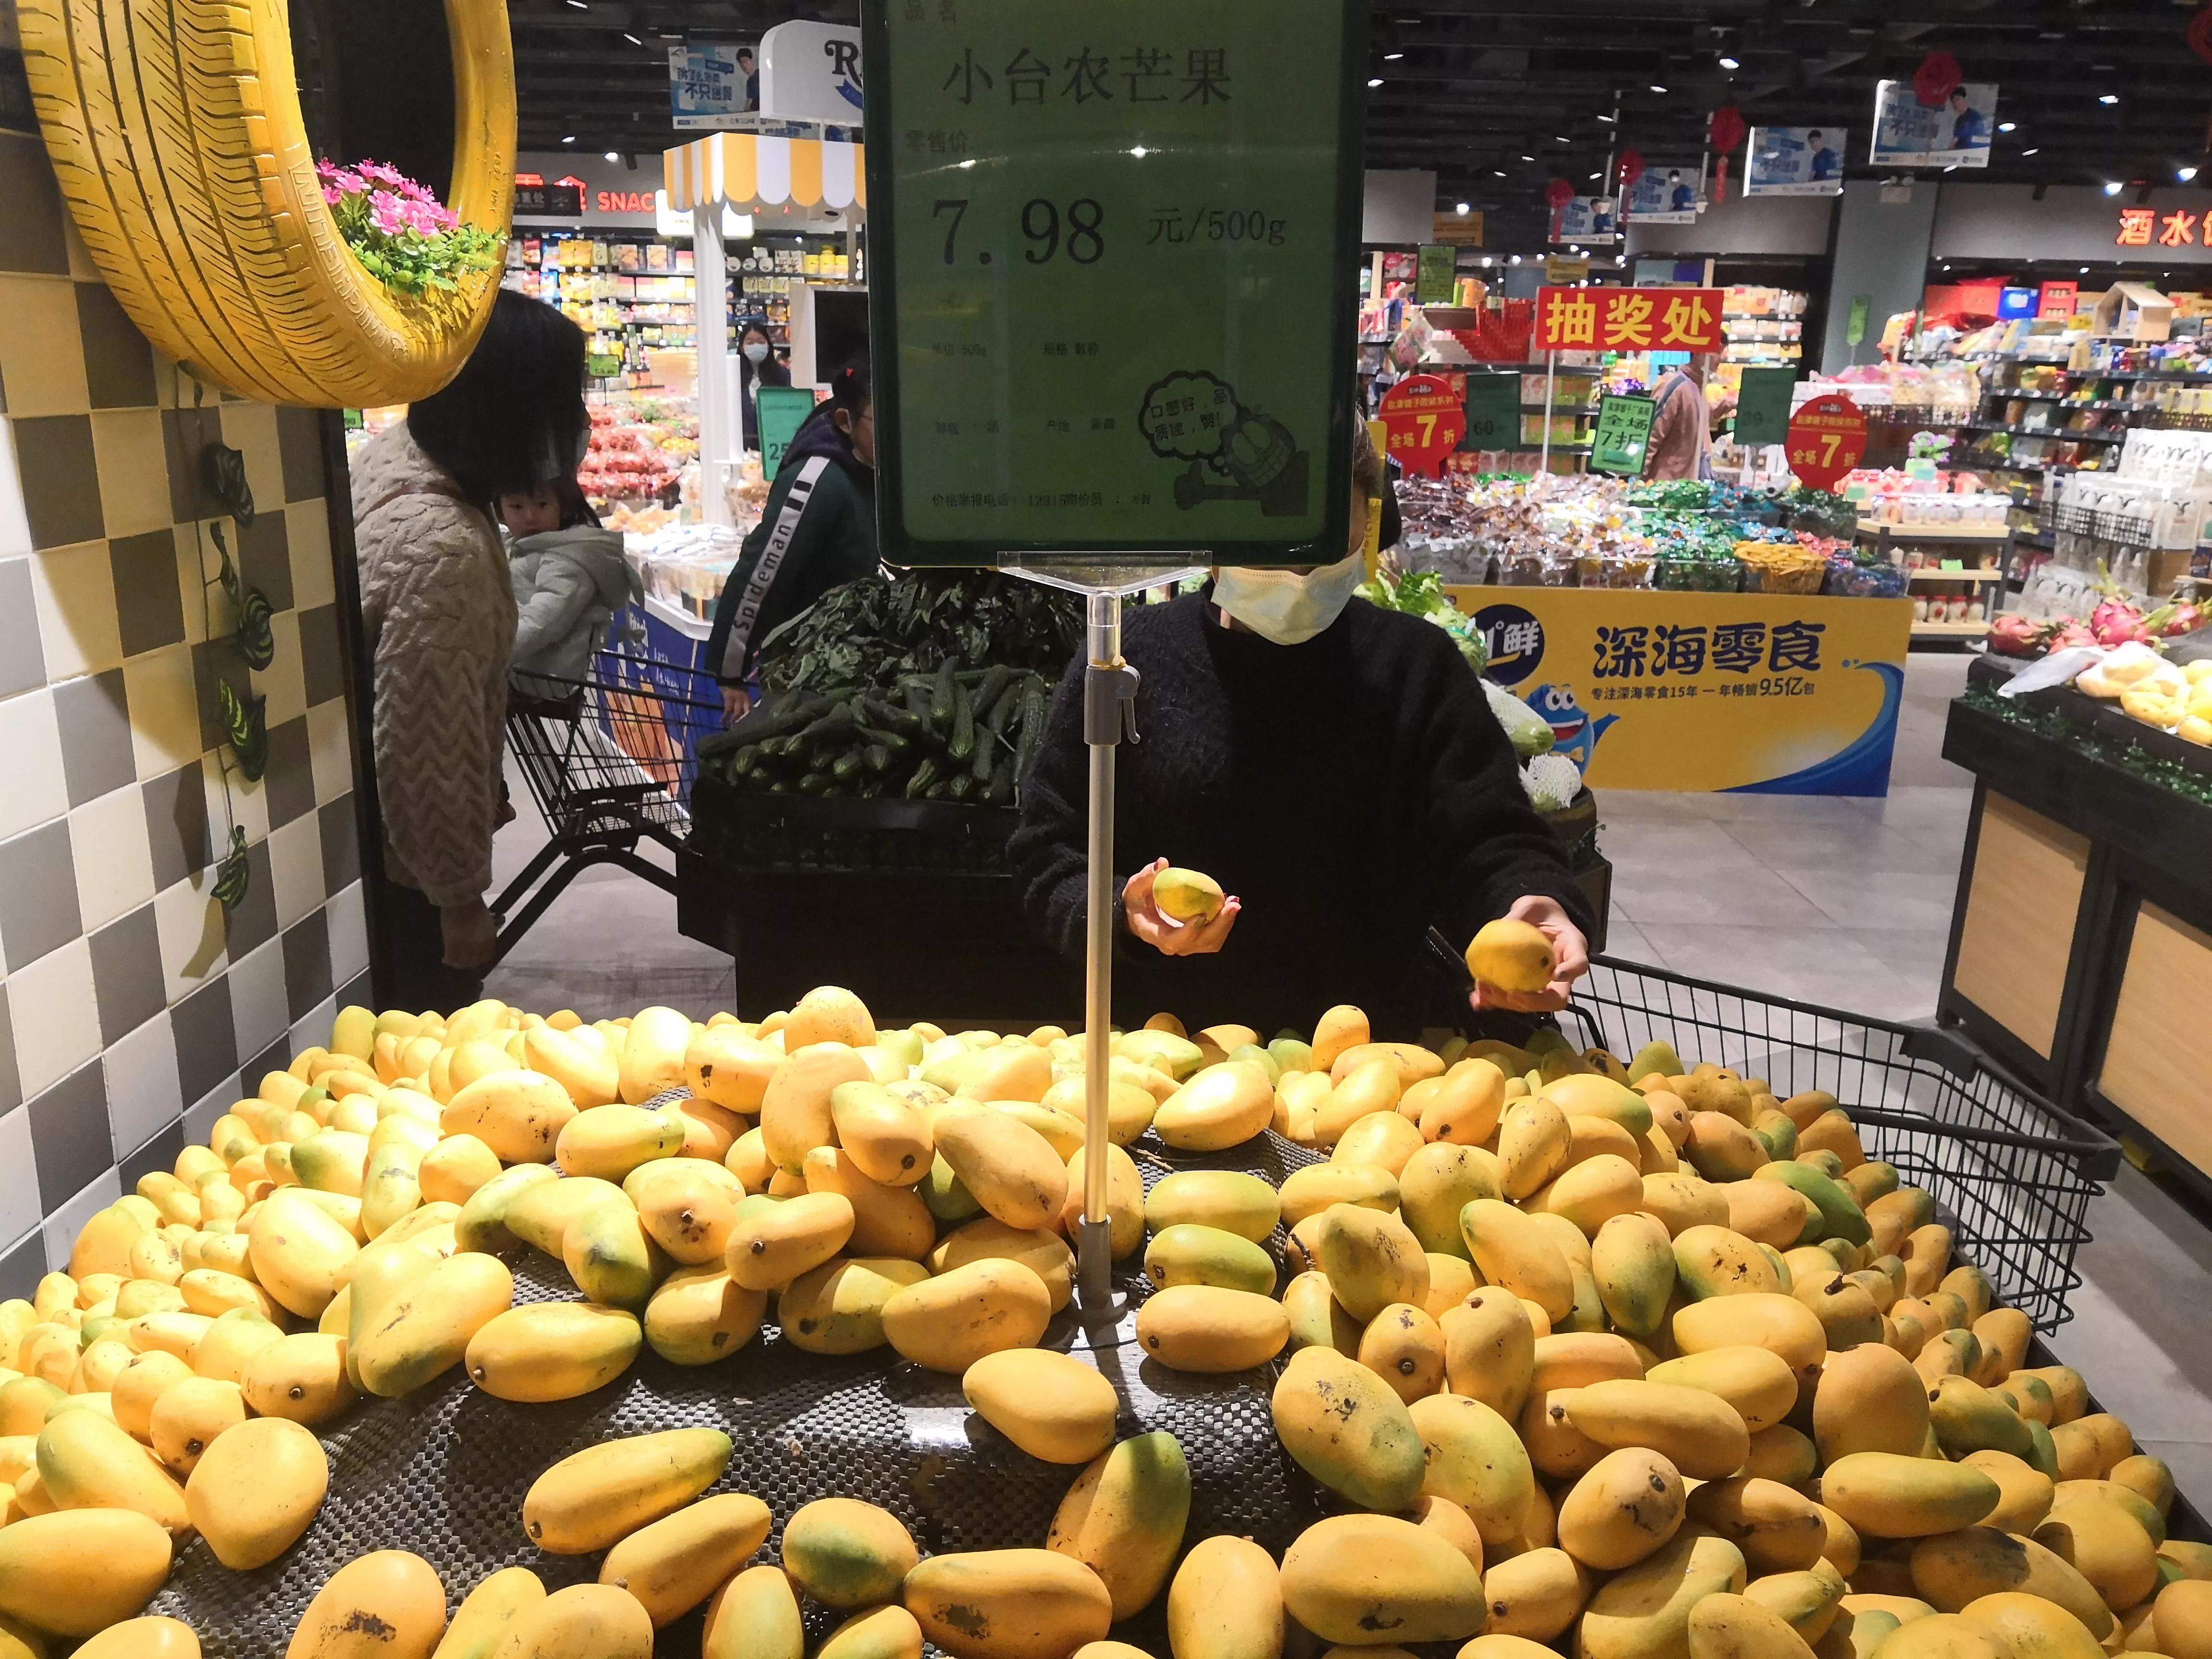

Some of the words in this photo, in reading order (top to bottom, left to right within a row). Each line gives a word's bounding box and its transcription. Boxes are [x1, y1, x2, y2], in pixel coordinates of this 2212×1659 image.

[943, 47, 1232, 105] 小台农芒果
[906, 130, 968, 153] 零售价
[933, 198, 1105, 264] 7.98
[1147, 206, 1286, 245] 元/500g
[1547, 292, 1712, 346] 抽奖处
[1417, 414, 1437, 448] 7
[1821, 434, 1842, 468] 7
[733, 524, 792, 631] Spideman
[1592, 620, 1826, 678] 深海零食
